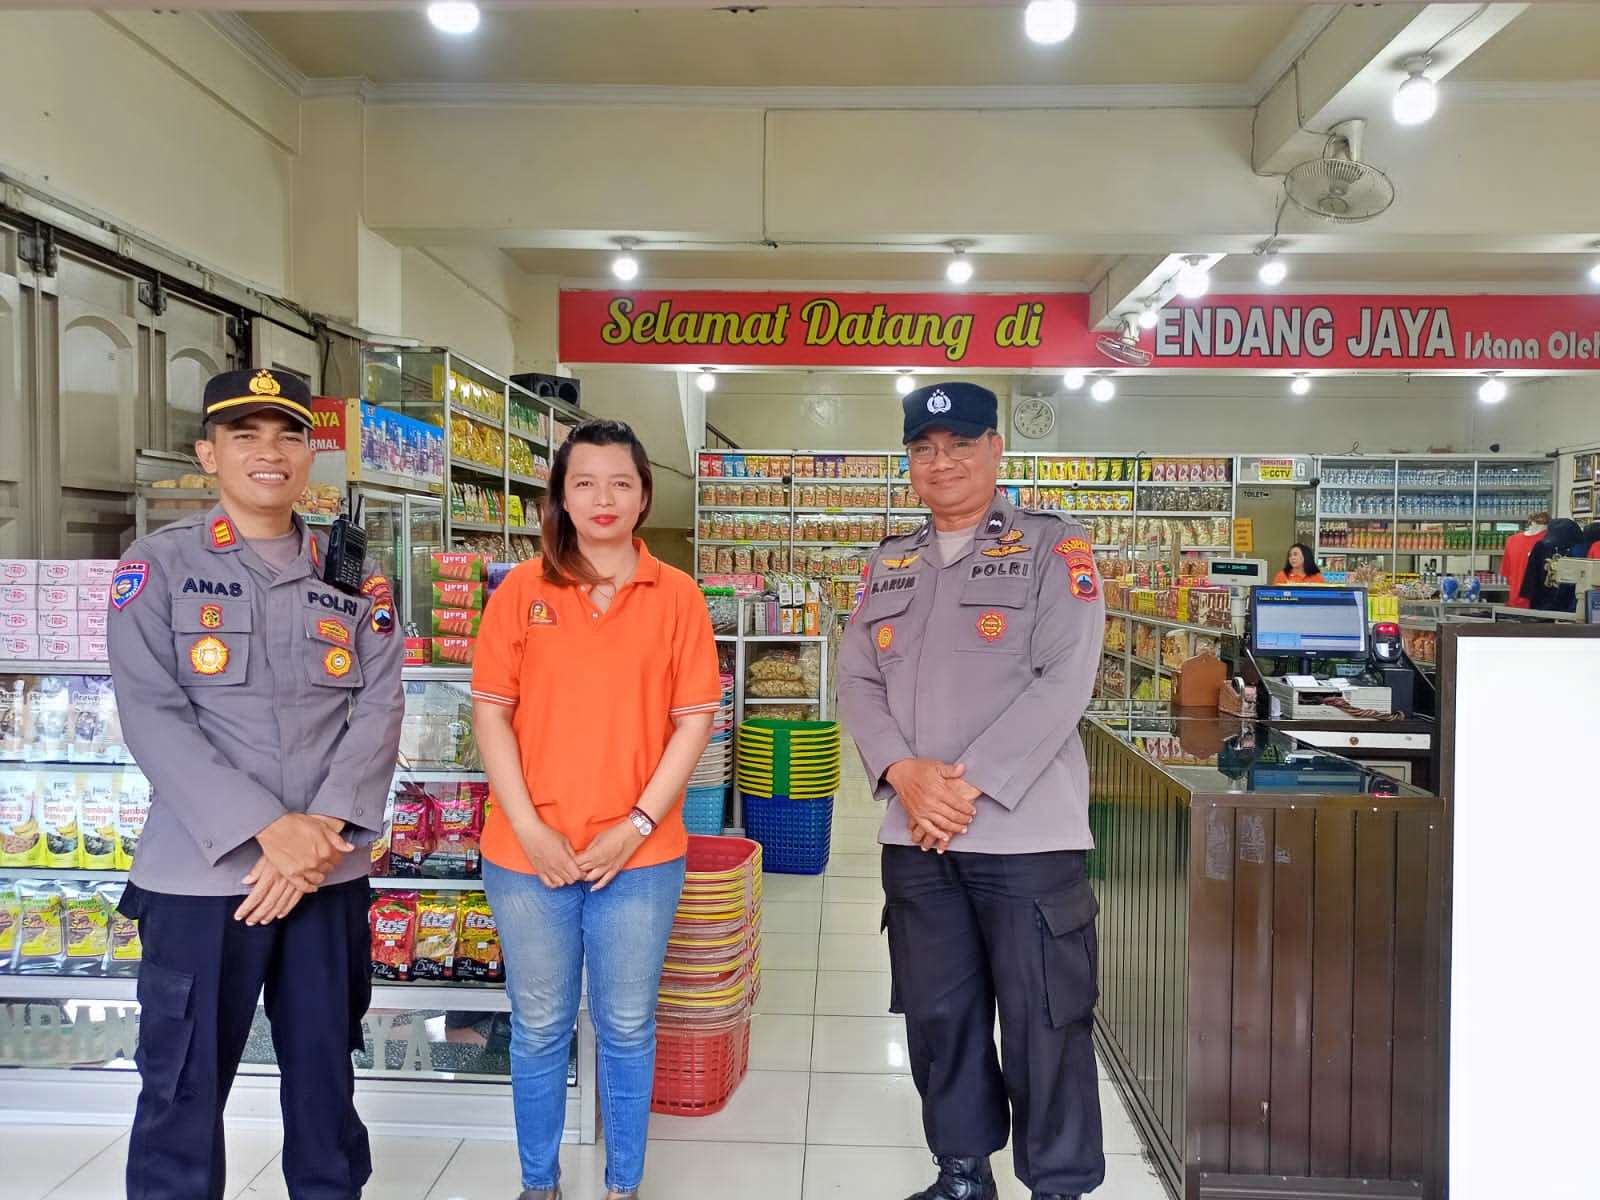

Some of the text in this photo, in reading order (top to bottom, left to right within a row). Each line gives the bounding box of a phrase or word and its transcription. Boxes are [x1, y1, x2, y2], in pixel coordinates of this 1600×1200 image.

[601, 297, 1044, 362] Selamat Datang di
[1154, 306, 1334, 358] ENDANG
[1347, 308, 1455, 359] JAYA
[1464, 331, 1539, 359] Istana
[1269, 470, 1292, 478] CCTV
[971, 562, 1029, 578] POLRI
[182, 577, 243, 597] ANAS
[308, 591, 358, 617] POLRI
